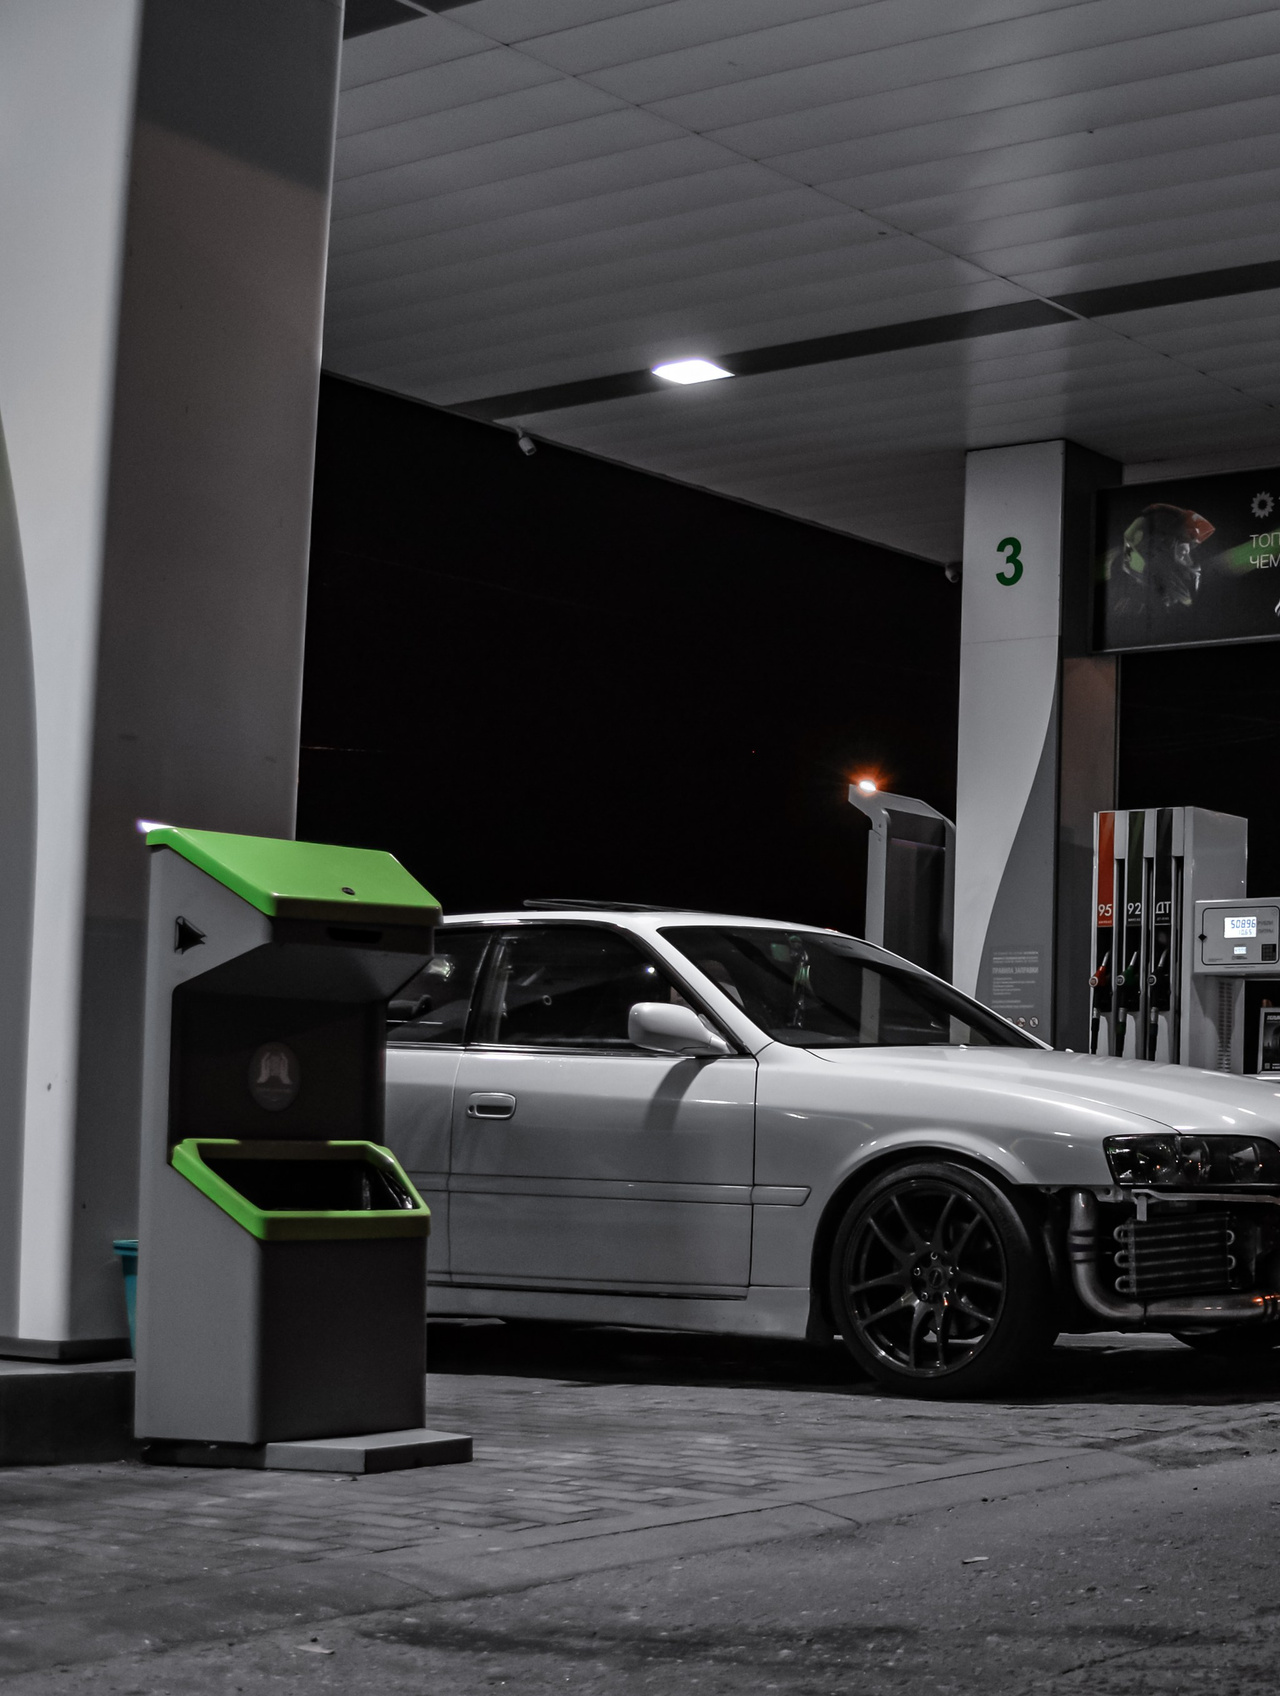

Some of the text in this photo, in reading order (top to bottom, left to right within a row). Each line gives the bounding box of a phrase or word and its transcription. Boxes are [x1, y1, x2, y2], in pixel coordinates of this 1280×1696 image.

[995, 536, 1024, 587] 3
[1098, 903, 1113, 917] 95
[1127, 902, 1142, 915] 92
[1155, 901, 1172, 914] ДТ
